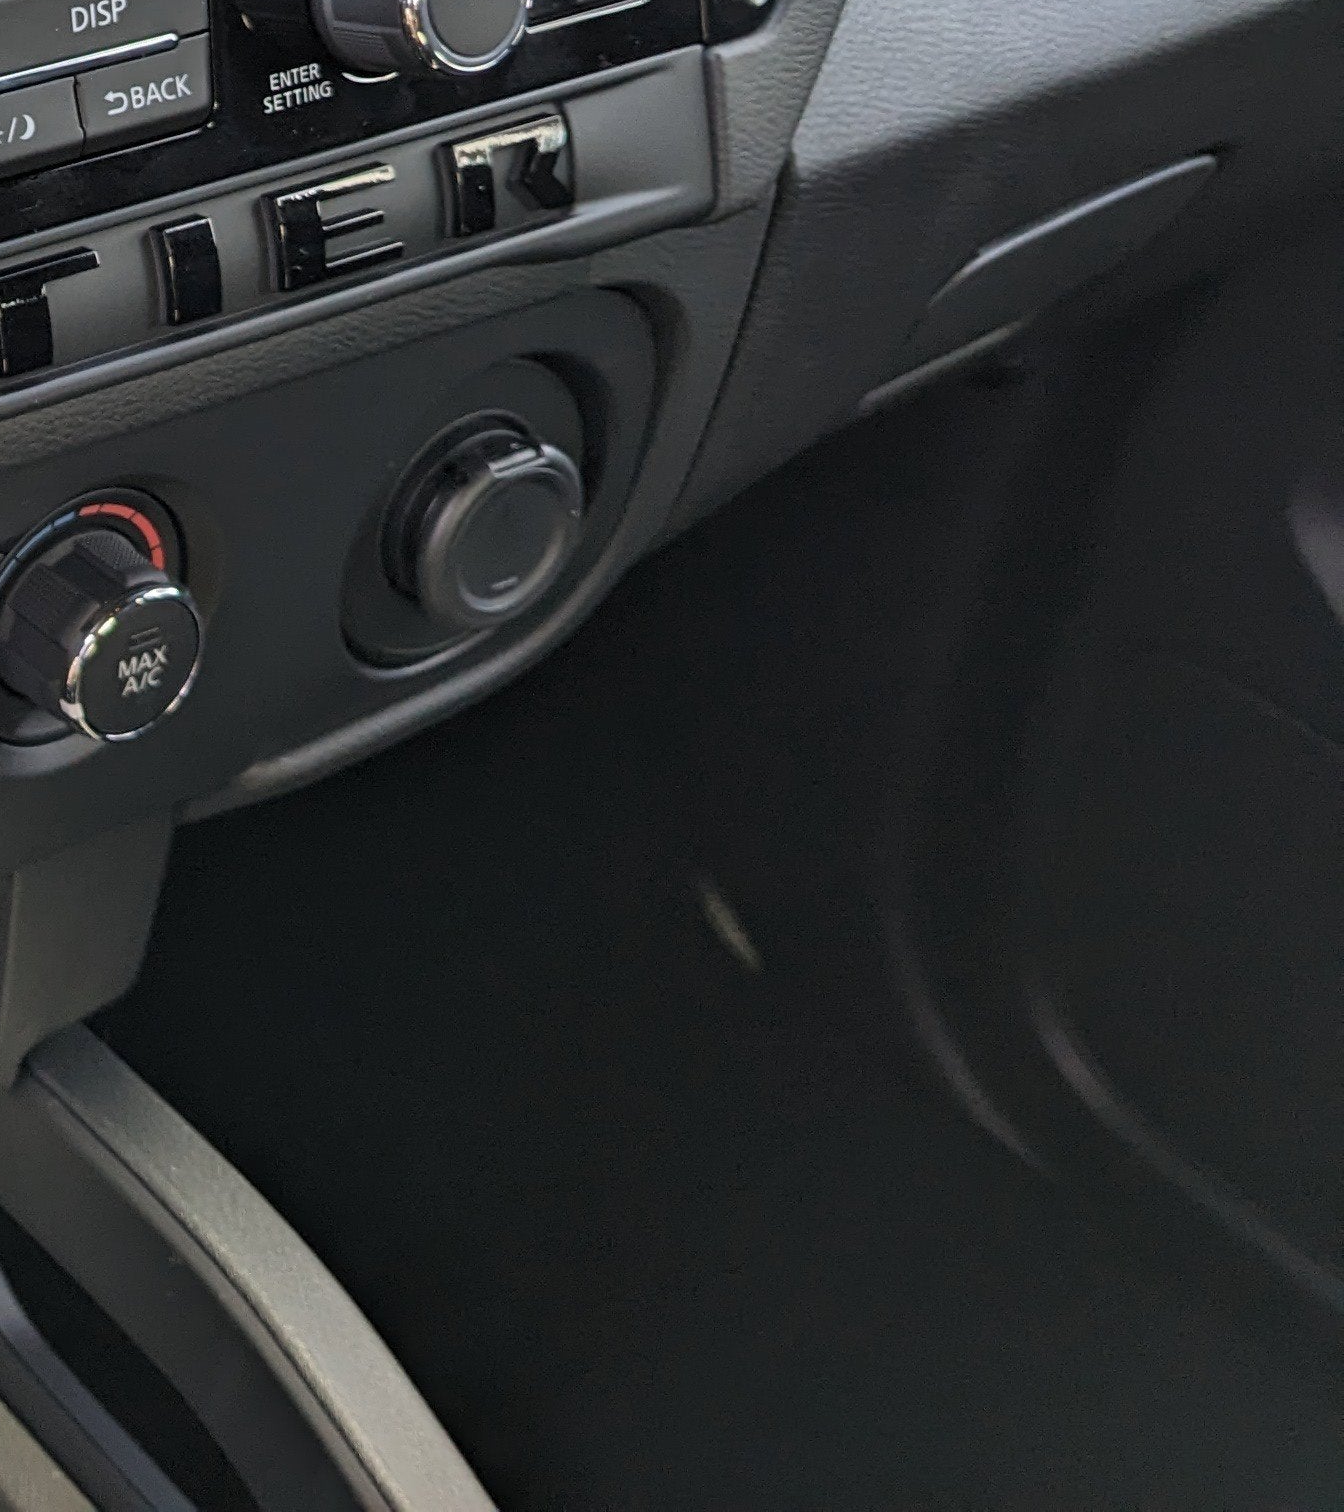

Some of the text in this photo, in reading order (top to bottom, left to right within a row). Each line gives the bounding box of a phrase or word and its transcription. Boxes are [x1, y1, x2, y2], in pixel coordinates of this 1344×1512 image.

[130, 74, 193, 111] BACK
[269, 63, 320, 91] ENTER
[263, 82, 332, 113] SETTING
[118, 645, 169, 679] MAX
[122, 667, 162, 696] A/C
